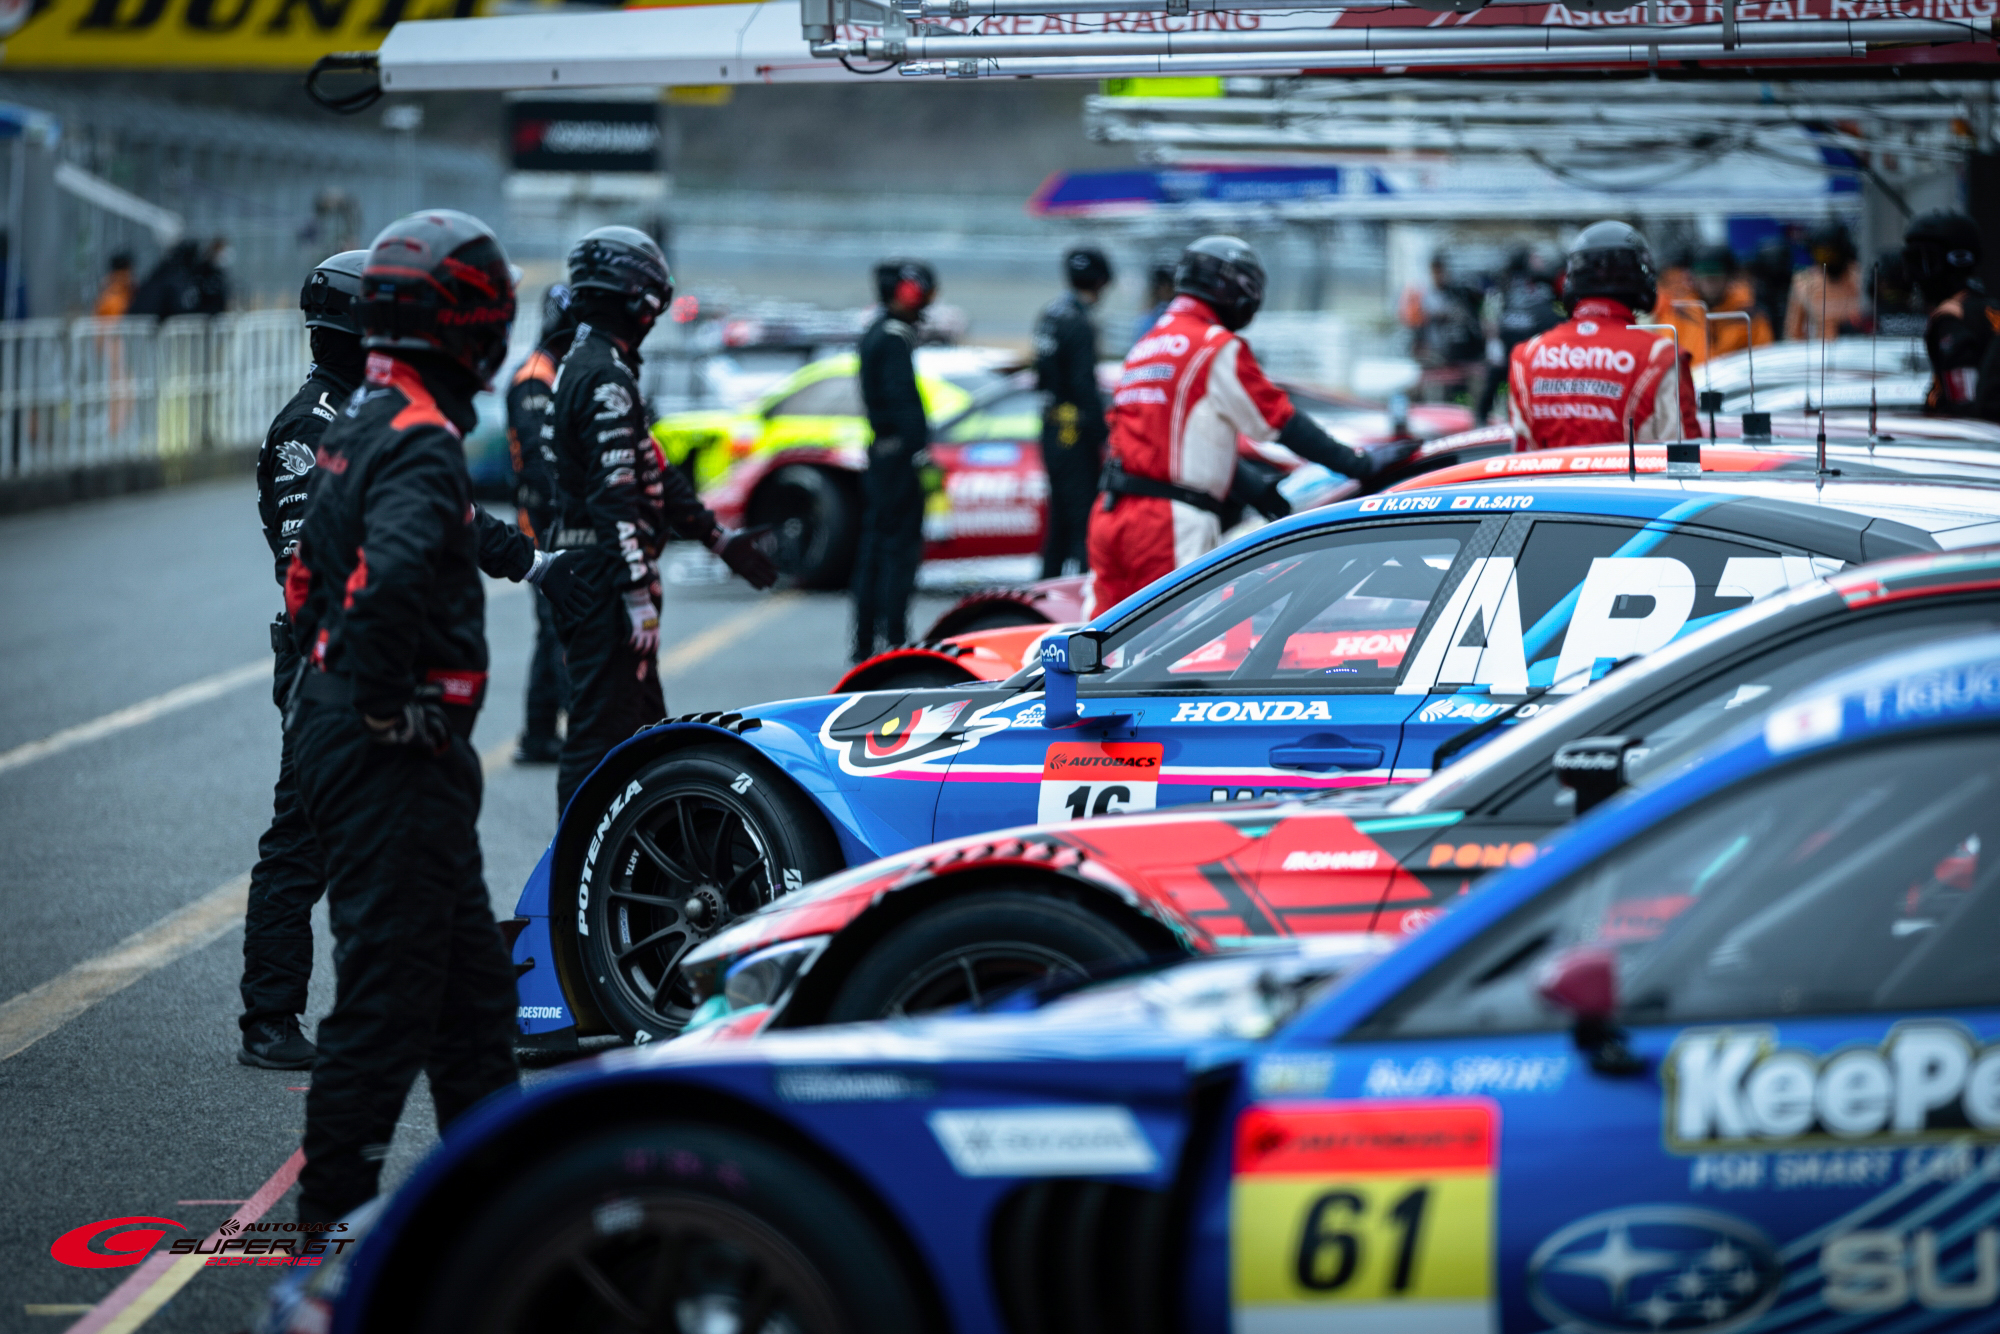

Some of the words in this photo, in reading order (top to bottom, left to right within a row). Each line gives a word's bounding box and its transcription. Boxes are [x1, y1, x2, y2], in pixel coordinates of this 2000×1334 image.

[1830, 0, 1998, 19] RACING
[983, 14, 1090, 35] REAL
[1101, 9, 1260, 33] RACING
[1531, 343, 1636, 374] Astemo
[1533, 403, 1618, 422] HONDA
[1383, 497, 1442, 511] H.OTSU
[1475, 496, 1534, 509] R.SATO
[555, 529, 598, 547] ARTA
[1171, 701, 1332, 722] HONDA
[1068, 756, 1157, 769] AUTOBACS
[578, 779, 643, 937] POTENZA
[625, 849, 640, 876] ARTA
[1428, 843, 1538, 869] PONO
[1292, 1182, 1440, 1300] 61
